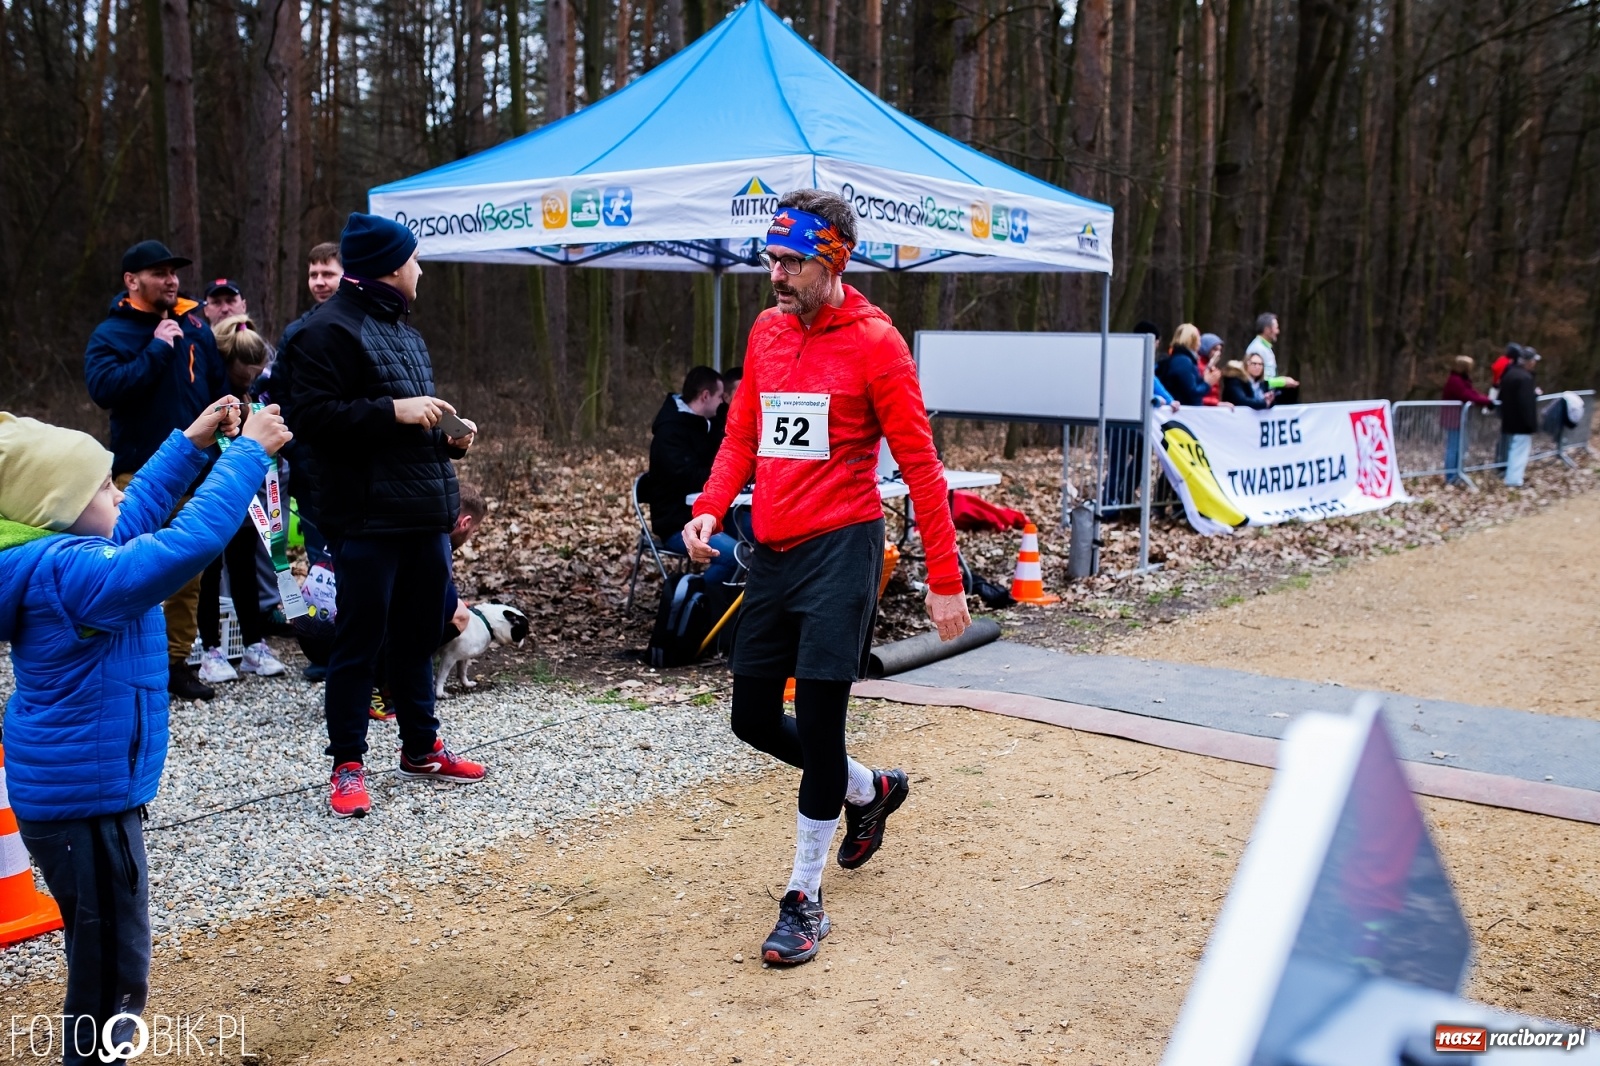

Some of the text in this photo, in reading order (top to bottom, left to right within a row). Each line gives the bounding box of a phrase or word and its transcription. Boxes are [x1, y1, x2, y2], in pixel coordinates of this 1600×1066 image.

[773, 417, 809, 446] 52
[1260, 419, 1302, 447] BIEG
[1228, 455, 1347, 496] TWARDZIELA
